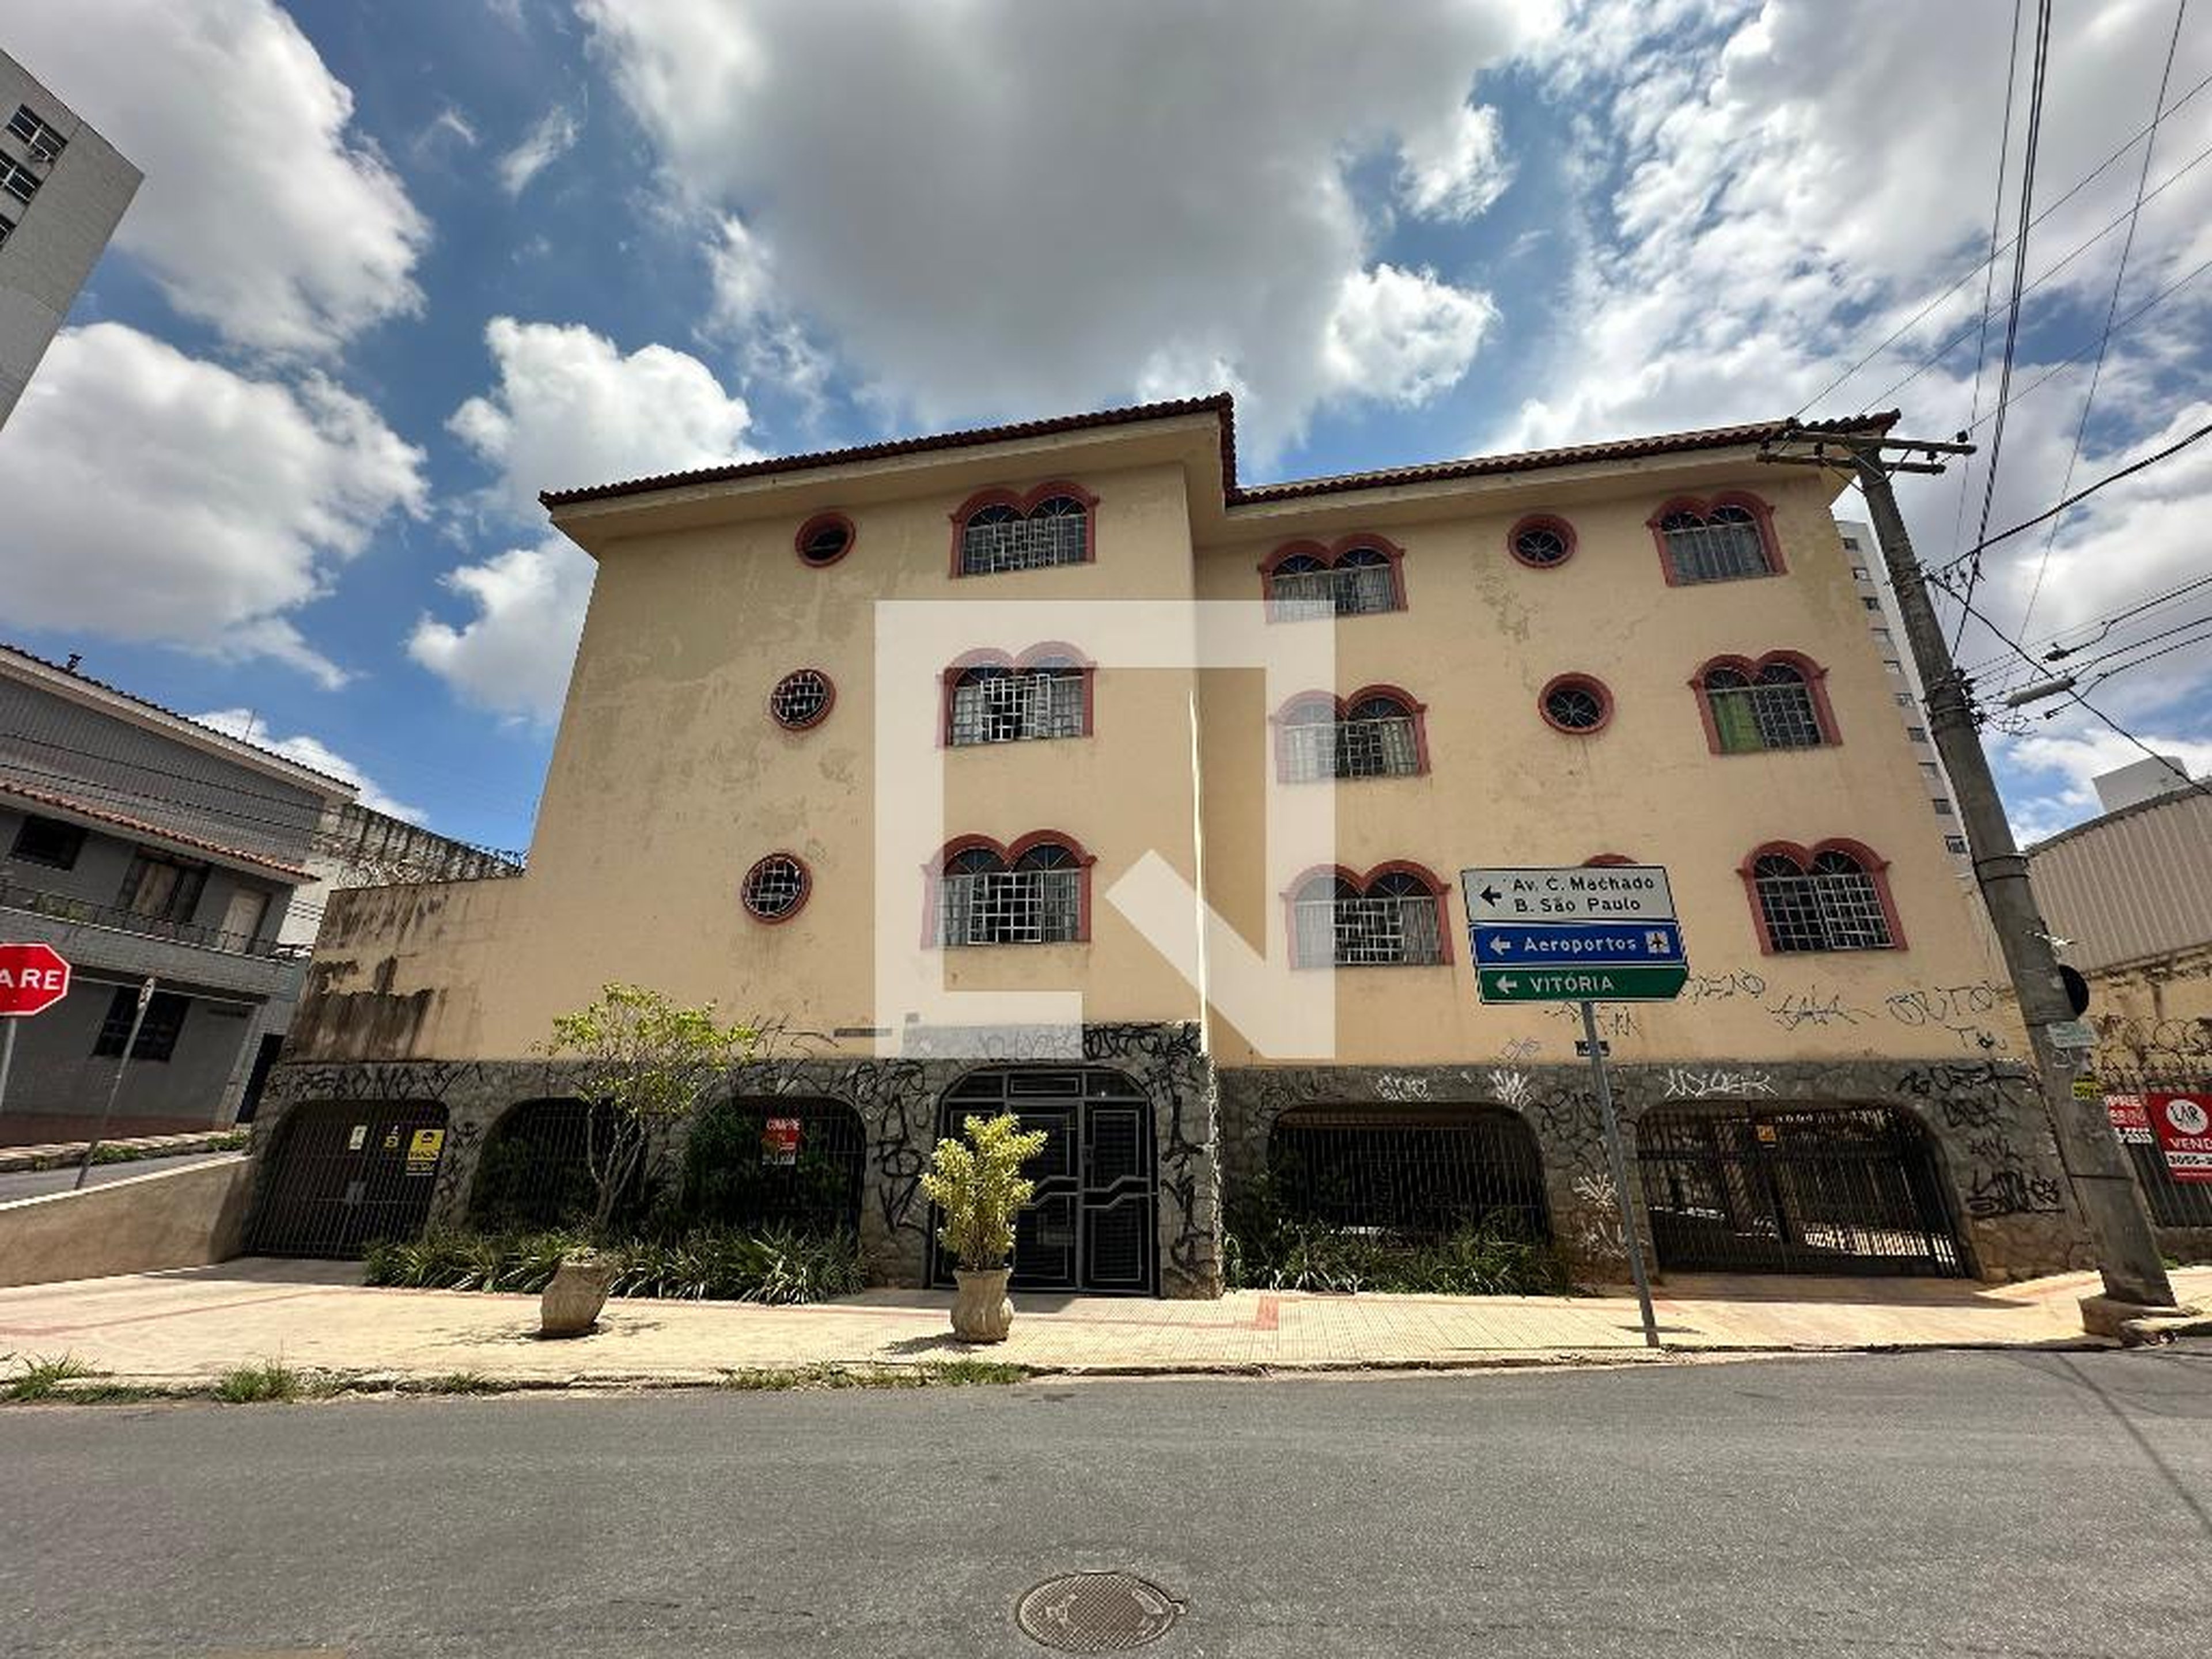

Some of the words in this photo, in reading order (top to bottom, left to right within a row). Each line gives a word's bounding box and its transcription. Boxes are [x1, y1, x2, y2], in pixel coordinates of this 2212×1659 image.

[1513, 878, 1538, 891] Av.
[1570, 877, 1654, 891] Machado
[1514, 898, 1534, 912] B.
[1540, 896, 1575, 912] São
[1587, 897, 1641, 911] Paulo
[1524, 937, 1637, 953] Aeroportos
[1530, 972, 1614, 992] VITÓRIA
